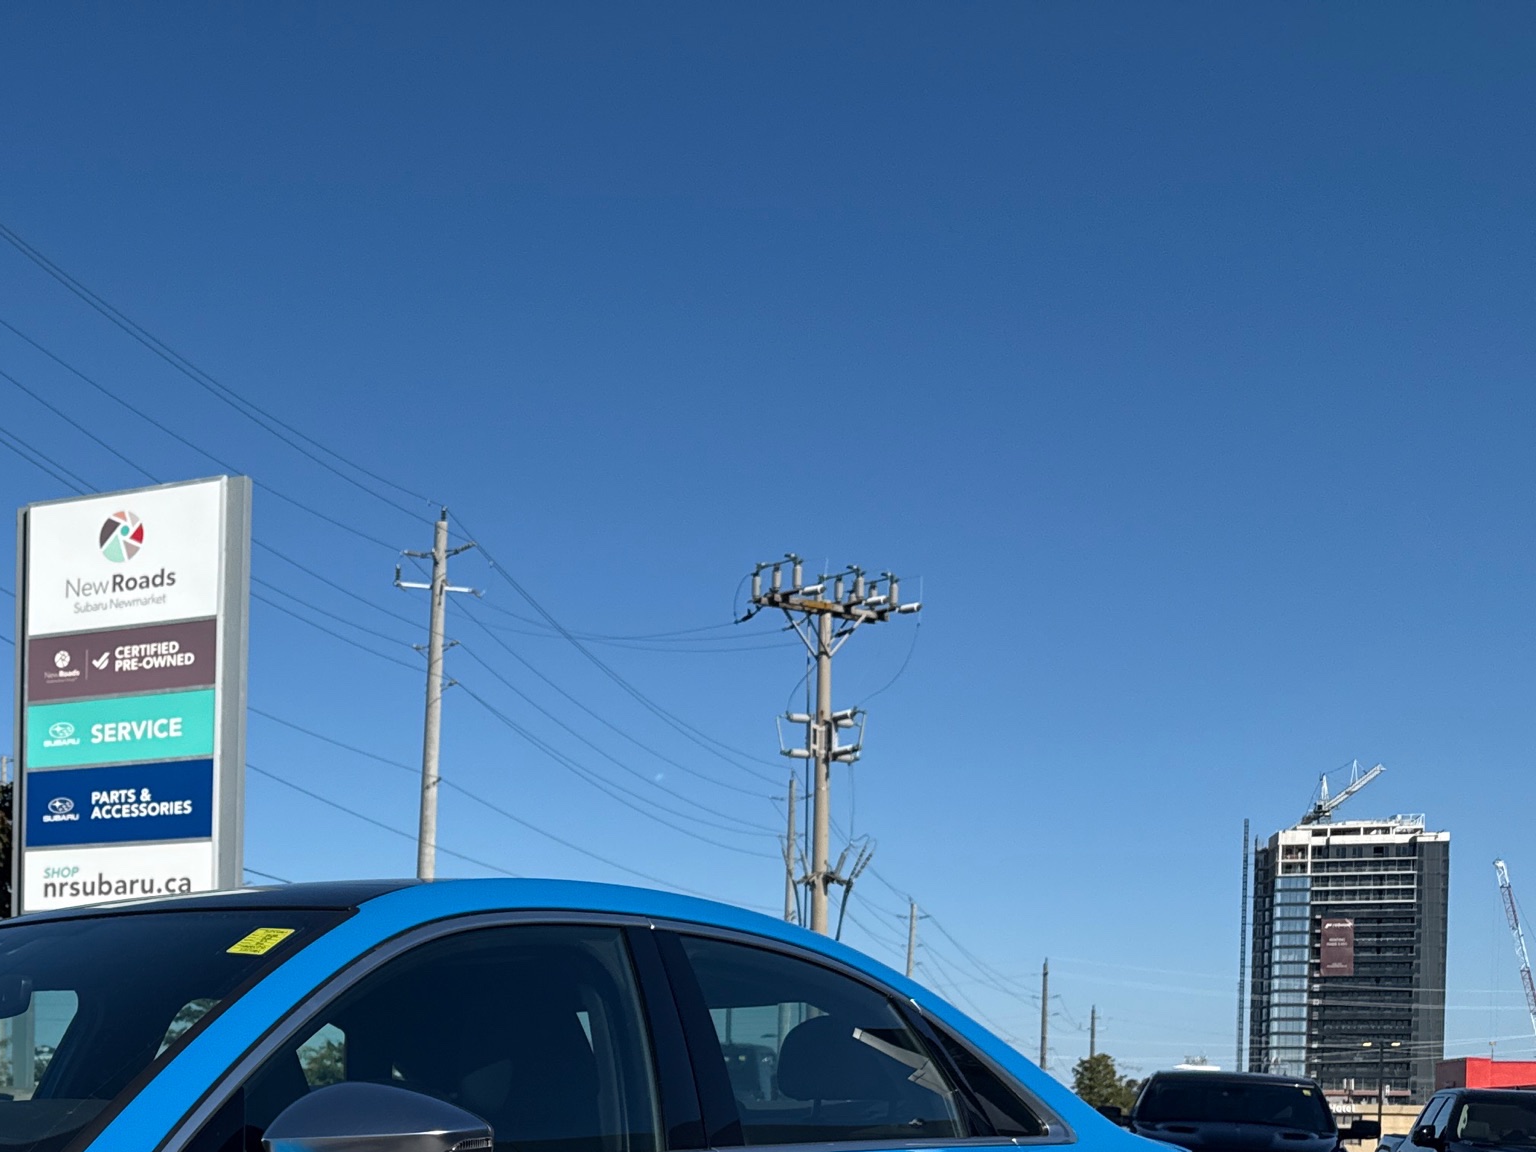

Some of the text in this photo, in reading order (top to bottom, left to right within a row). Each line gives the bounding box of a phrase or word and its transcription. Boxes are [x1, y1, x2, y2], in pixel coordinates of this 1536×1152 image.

[73, 593, 167, 614] Subaru Newmarket
[114, 641, 180, 660] CERTIFIED
[114, 652, 195, 672] PRE-OWNED
[90, 717, 183, 744] SERVICE
[43, 737, 80, 748] SUBARU
[90, 788, 152, 805] PARTS &
[42, 812, 80, 823] SUBARU
[90, 800, 193, 820] ACCESSORIES
[43, 866, 80, 879] SHOP
[43, 872, 191, 898] nrsubaru.ca
